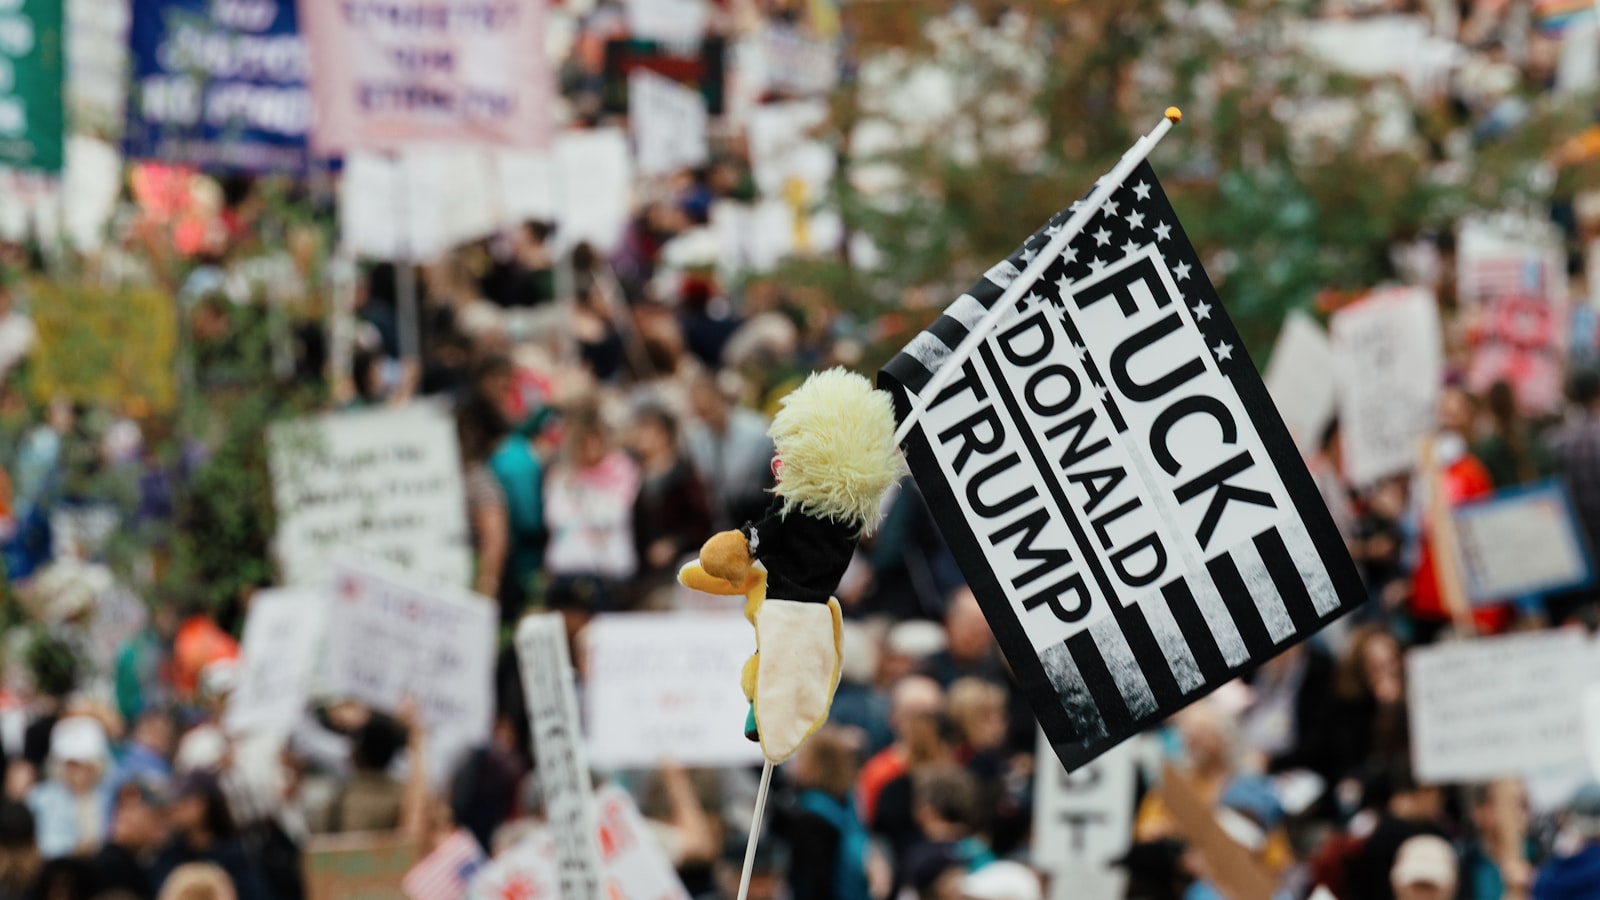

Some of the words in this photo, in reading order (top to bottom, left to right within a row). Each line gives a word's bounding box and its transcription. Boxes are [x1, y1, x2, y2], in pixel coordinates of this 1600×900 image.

[925, 356, 1093, 624] TRUMP
[997, 314, 1168, 588] DONALD
[1072, 255, 1278, 552] FUCK
